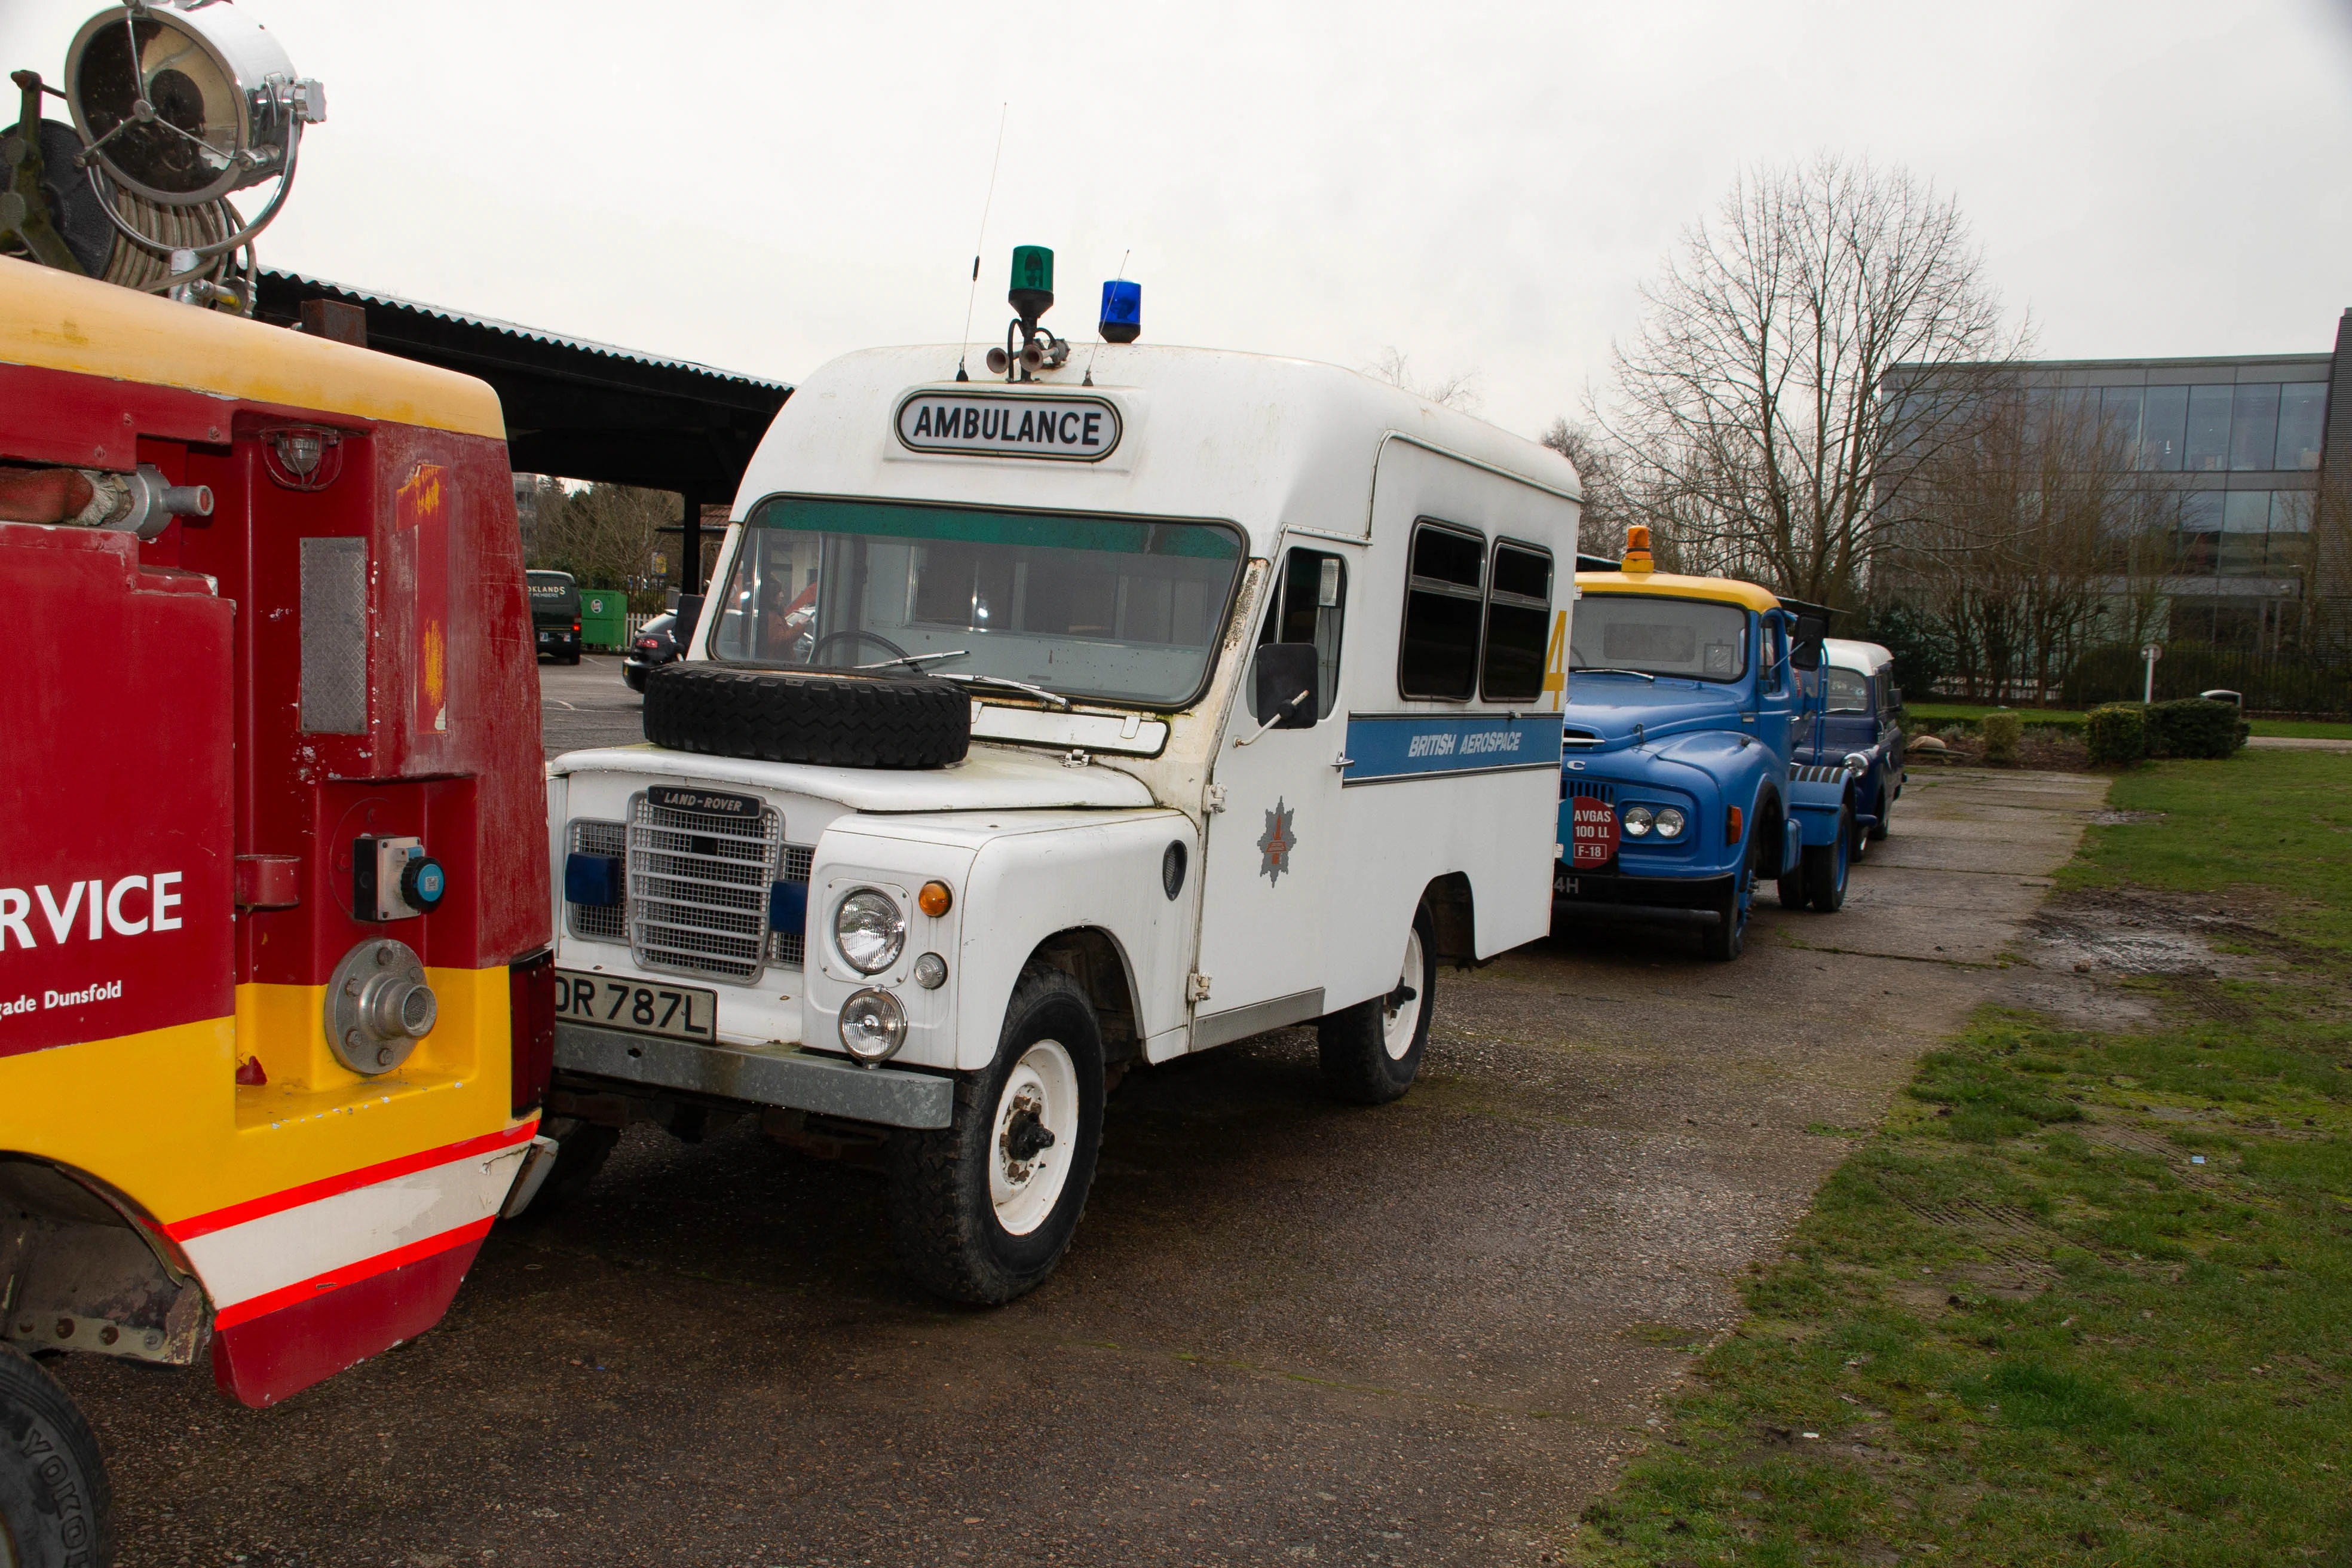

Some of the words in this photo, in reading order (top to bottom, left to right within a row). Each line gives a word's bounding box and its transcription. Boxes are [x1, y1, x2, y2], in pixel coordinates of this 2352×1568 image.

[913, 406, 1101, 446] AMBULANCE
[1408, 734, 1457, 757] BRITISH
[1459, 731, 1522, 755] AEROSPACE
[664, 792, 743, 812] LAND-ROVER
[1574, 810, 1612, 822] AVGAS
[1575, 826, 1594, 838] 100
[1598, 826, 1610, 838] LL
[1578, 846, 1601, 857] F-18
[1554, 877, 1579, 893] 4H
[0, 871, 182, 951] RVICE
[0, 994, 36, 1021] ade
[45, 979, 121, 1009] Dunsfold
[607, 984, 708, 1035] 787L
